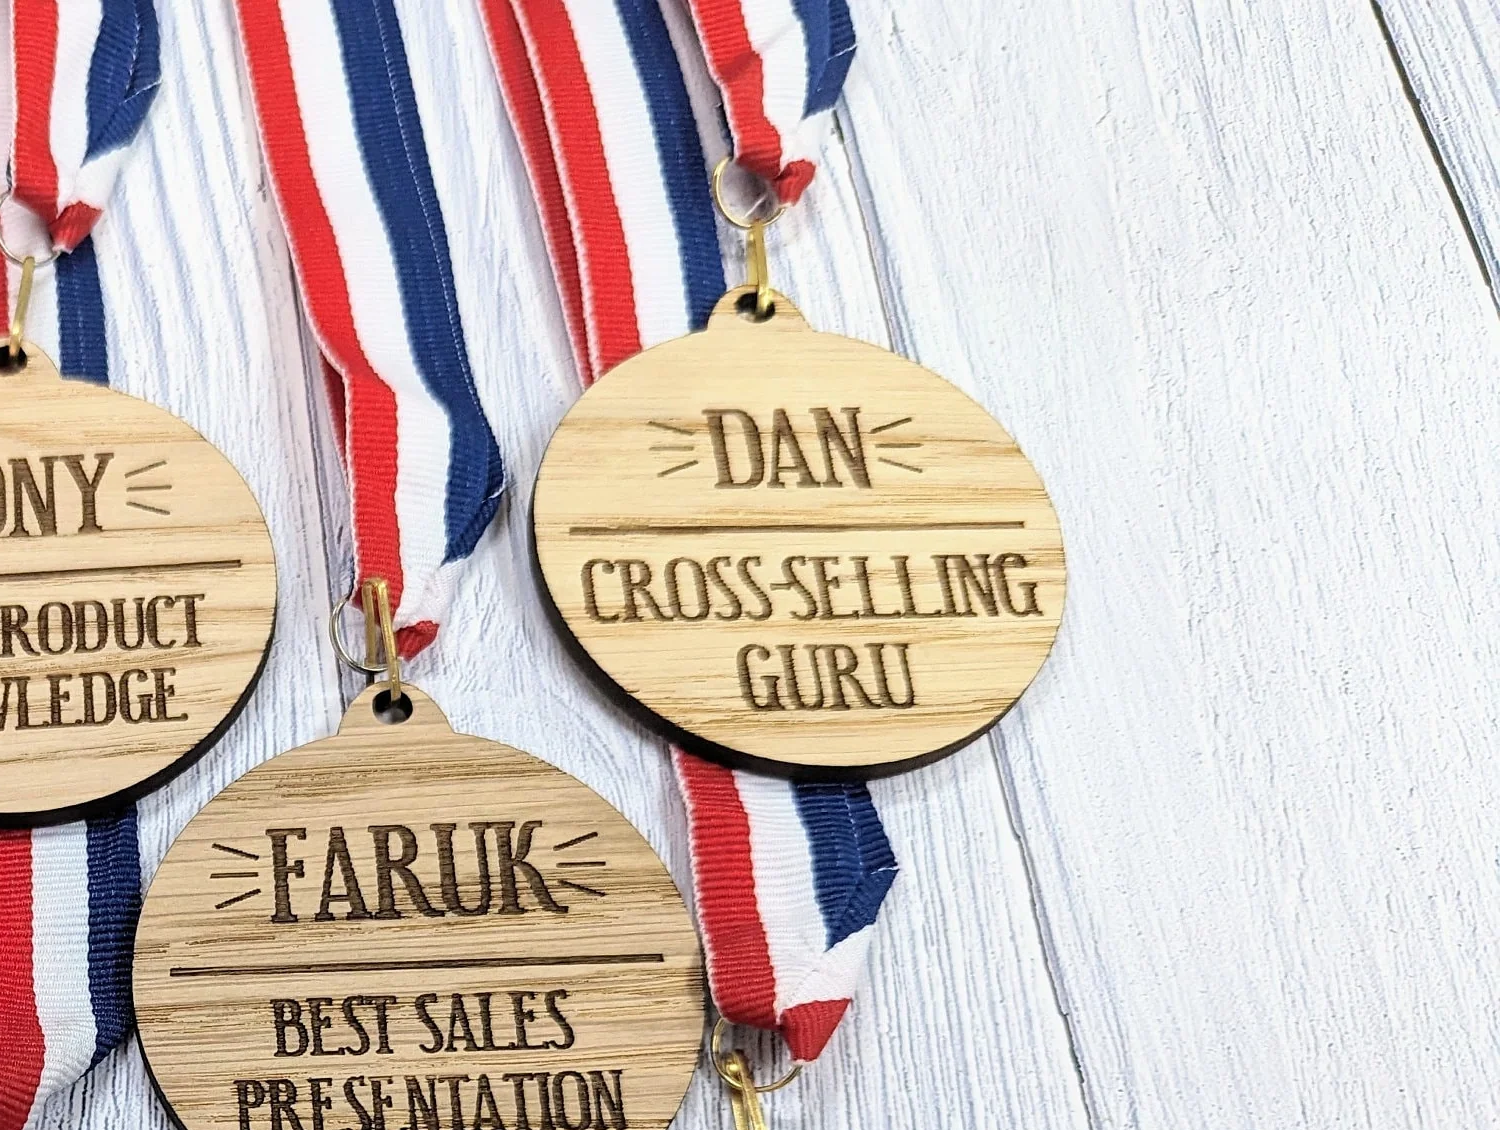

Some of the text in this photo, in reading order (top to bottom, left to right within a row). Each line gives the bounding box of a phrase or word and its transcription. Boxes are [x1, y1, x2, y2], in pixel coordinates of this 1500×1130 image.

[702, 406, 872, 490] DAN
[580, 552, 1044, 624] CROSS-SELLING
[736, 642, 916, 711] GURU
[266, 819, 568, 923] FARUK
[270, 989, 575, 1058] BEST SALES
